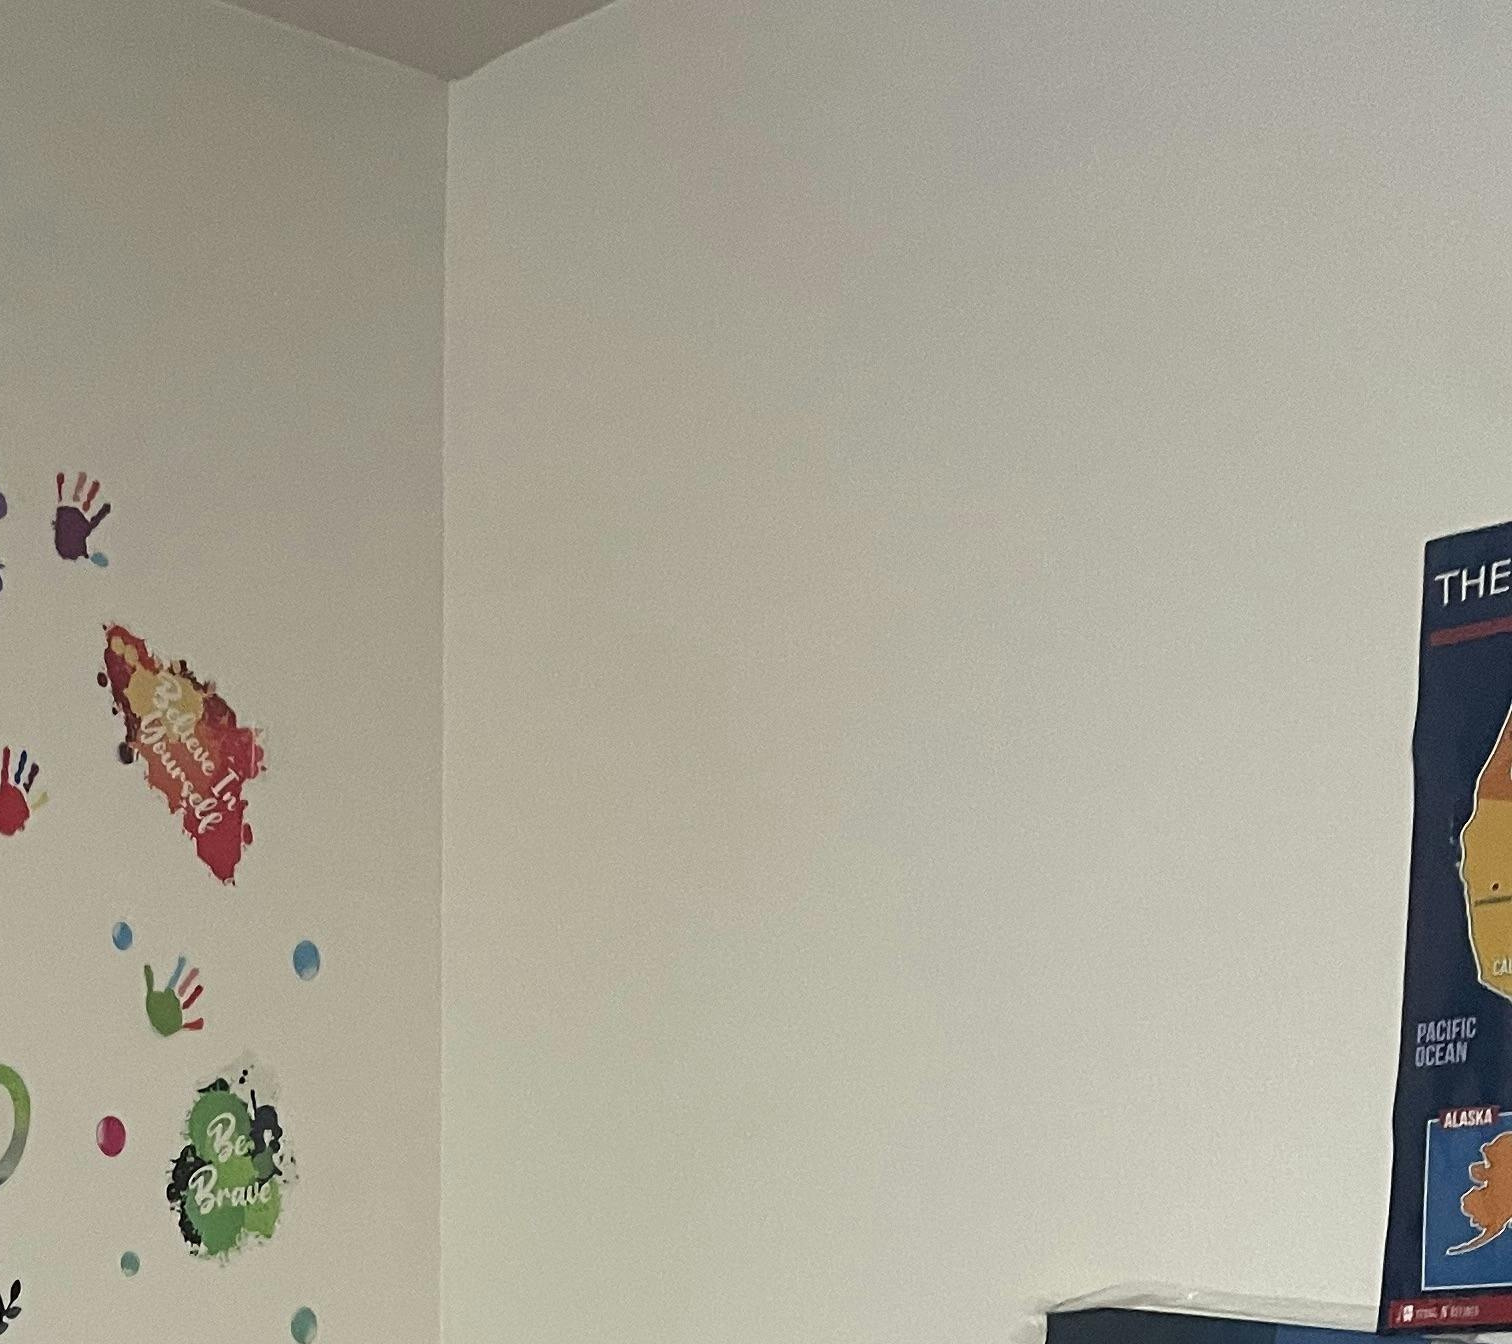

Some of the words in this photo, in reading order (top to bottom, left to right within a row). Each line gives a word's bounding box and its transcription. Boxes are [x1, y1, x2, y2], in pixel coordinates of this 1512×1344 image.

[1434, 558, 1512, 607] THE
[153, 672, 215, 776] Believe
[210, 767, 239, 812] In
[140, 711, 223, 834] Yourself
[1415, 1041, 1468, 1067] OCEAN
[1417, 1017, 1477, 1043] PACIFIC
[207, 1112, 251, 1163] Be
[1443, 1108, 1493, 1129] ALASKA
[189, 1164, 272, 1215] Brave
